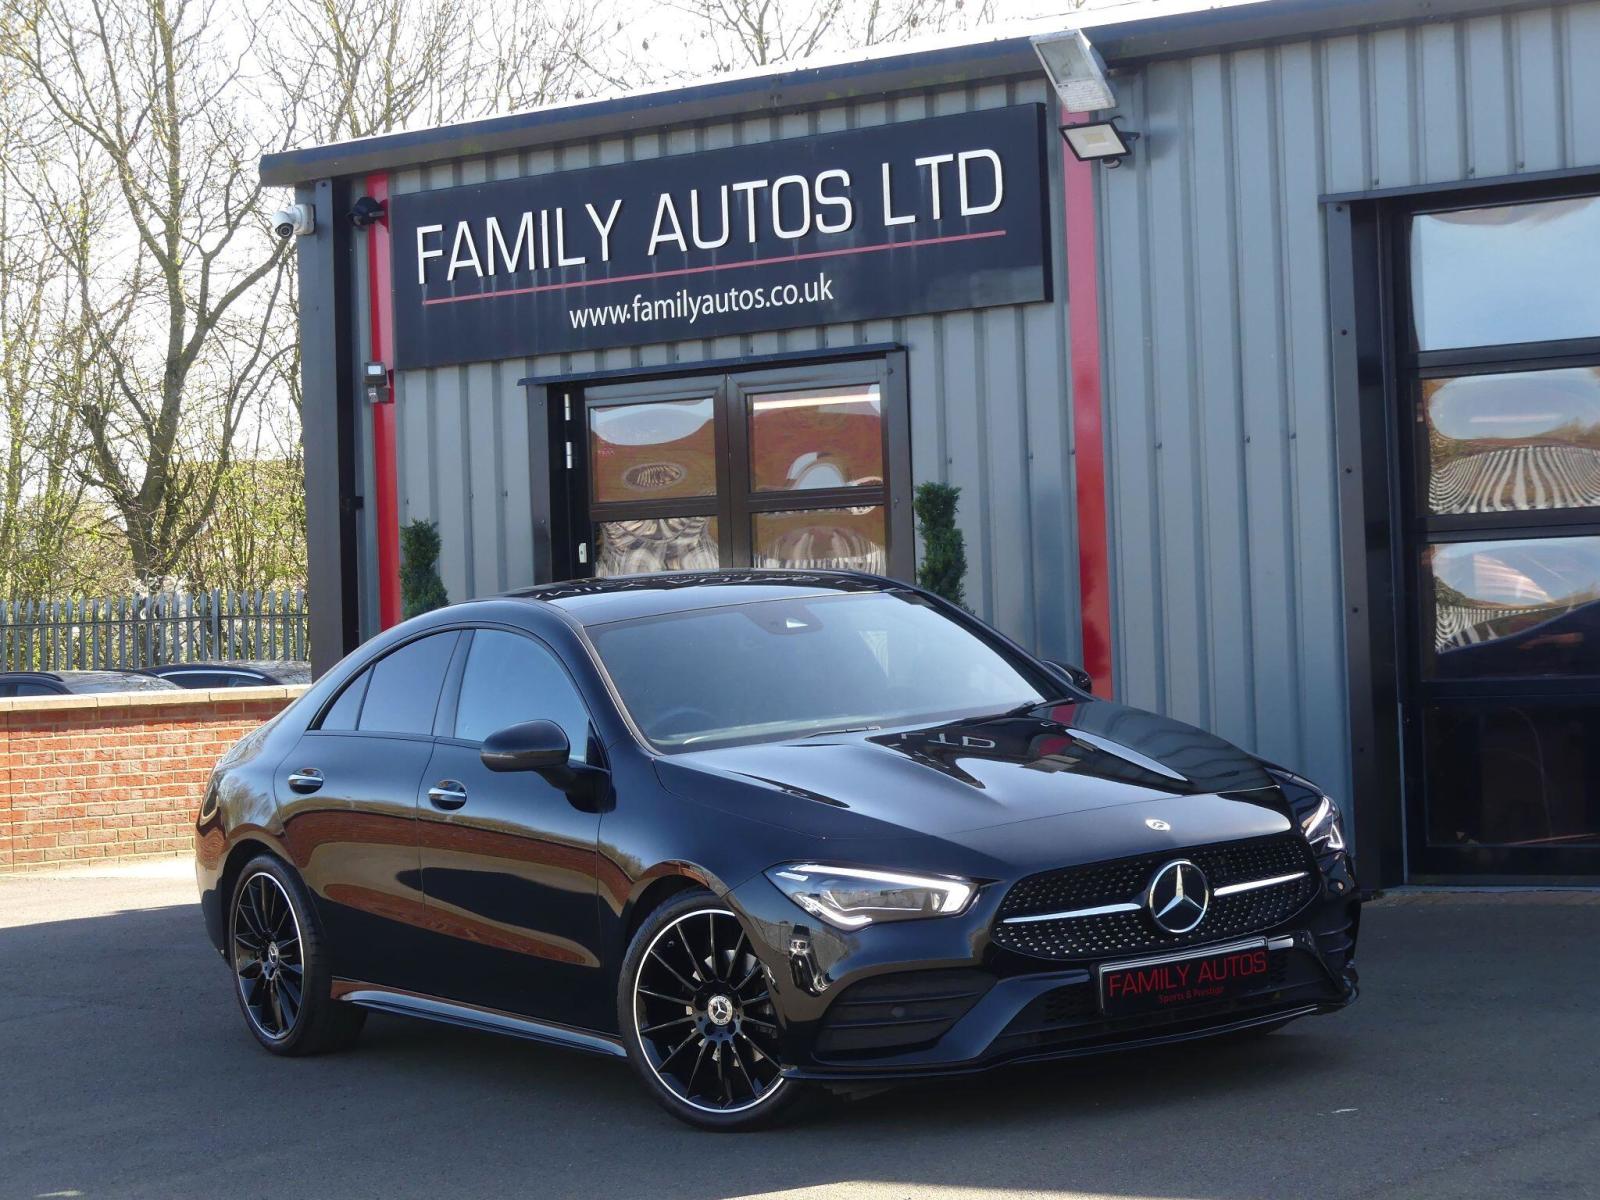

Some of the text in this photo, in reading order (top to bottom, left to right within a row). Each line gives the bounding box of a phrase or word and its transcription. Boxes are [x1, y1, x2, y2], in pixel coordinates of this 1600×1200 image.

[416, 147, 1005, 285] FAMILY AUTOS LTD
[569, 272, 834, 329] www.familyautos.co.uk
[1108, 951, 1267, 996] FAMILY AUTOS
